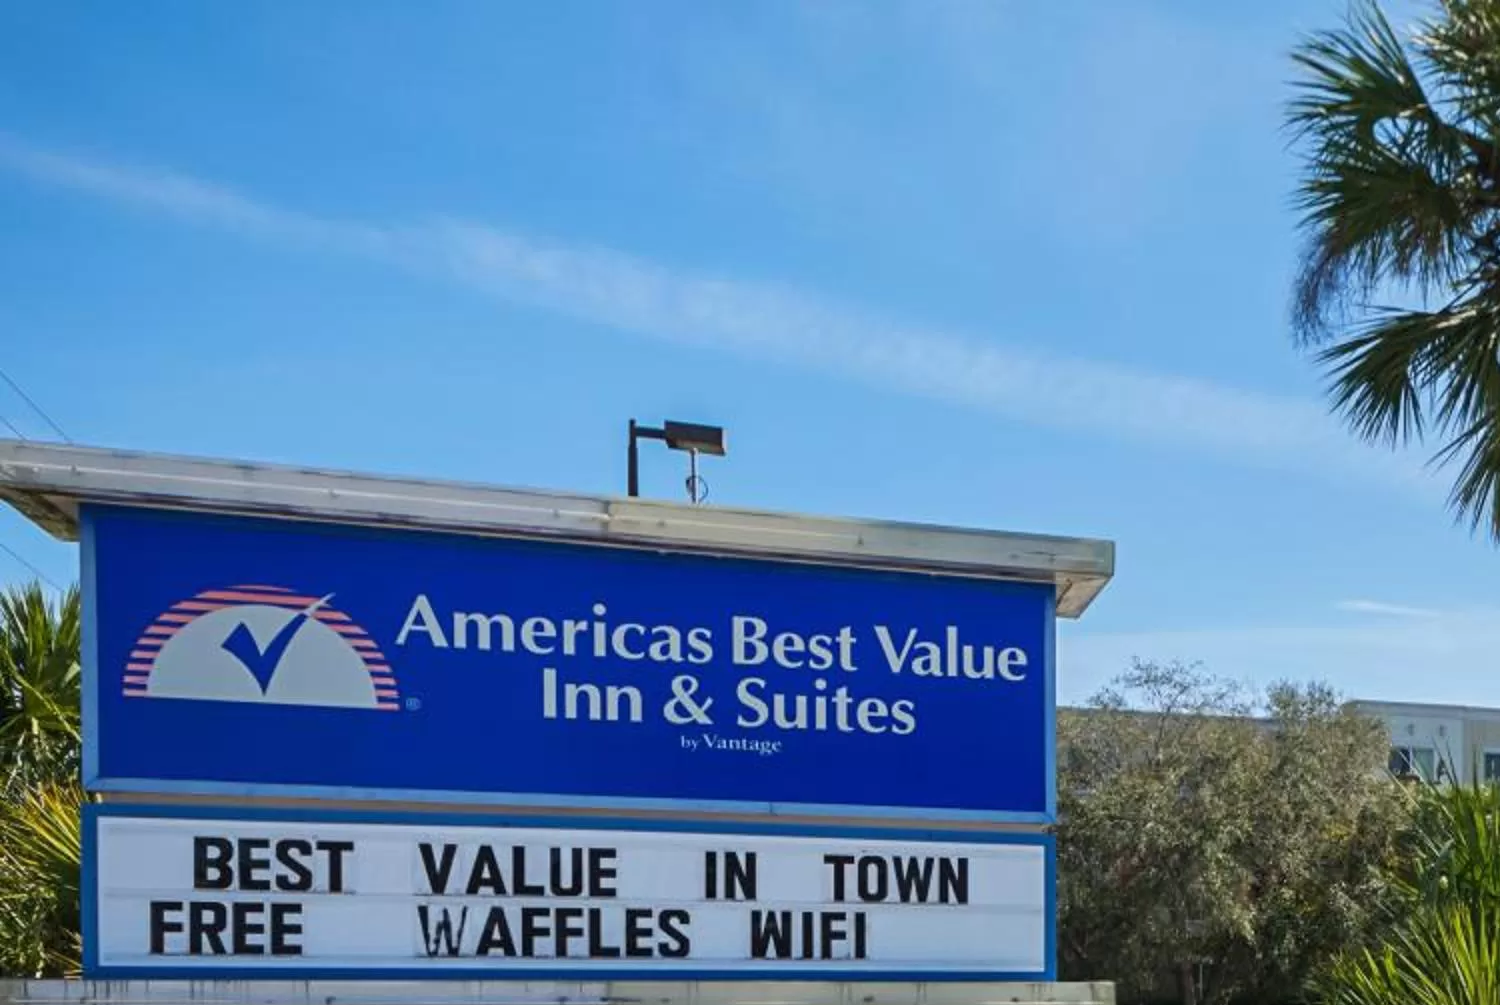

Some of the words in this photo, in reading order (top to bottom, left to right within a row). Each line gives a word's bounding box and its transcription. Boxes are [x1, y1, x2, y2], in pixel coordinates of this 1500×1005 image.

[396, 593, 714, 664] Americas
[732, 614, 858, 672] Best
[874, 624, 1029, 681] Value
[543, 667, 643, 722] Inn
[663, 675, 713, 725] &
[736, 677, 915, 735] Suites
[680, 735, 698, 751] by
[703, 733, 782, 755] Vantage
[193, 835, 355, 895] BEST
[418, 842, 617, 899] VALUE
[704, 850, 757, 902] IN
[823, 853, 969, 905] TOWN
[148, 900, 304, 958] FREE
[416, 904, 691, 960] WAFFLES
[749, 909, 867, 961] WIFI
